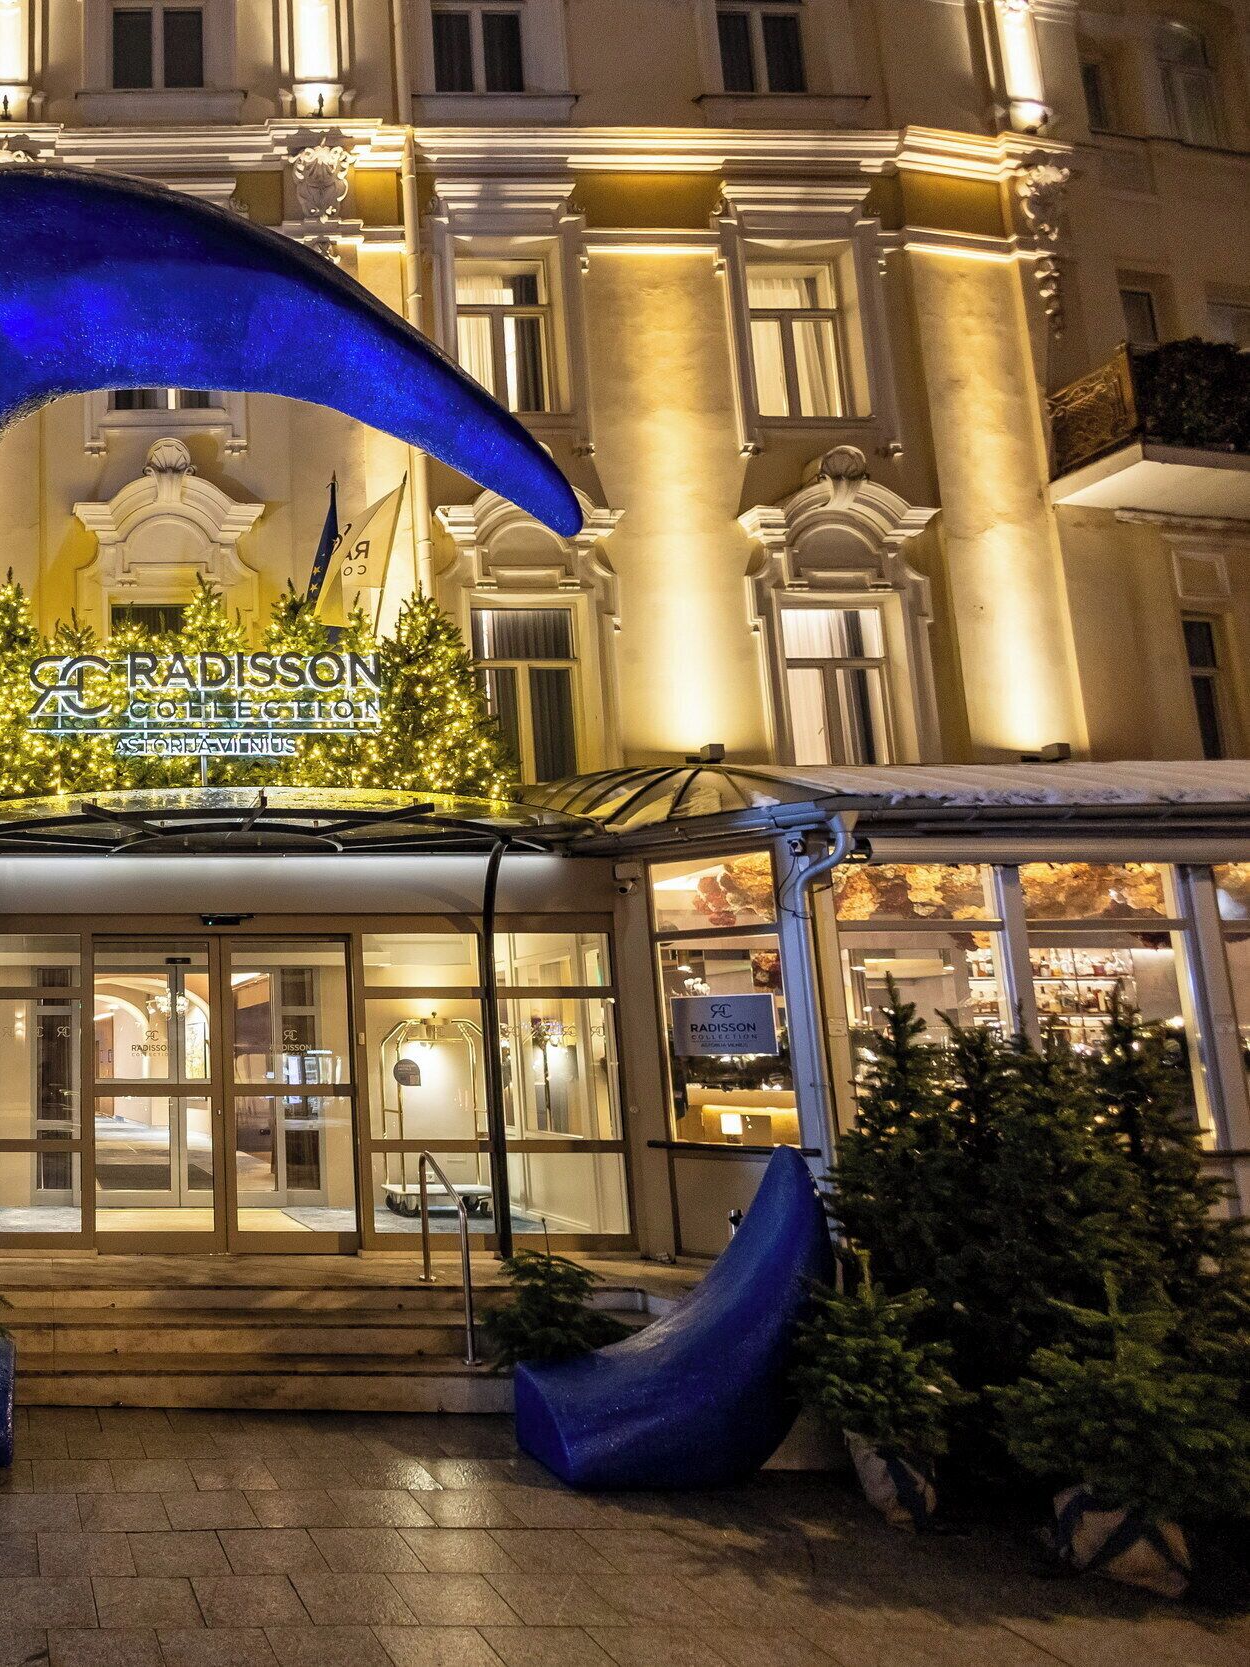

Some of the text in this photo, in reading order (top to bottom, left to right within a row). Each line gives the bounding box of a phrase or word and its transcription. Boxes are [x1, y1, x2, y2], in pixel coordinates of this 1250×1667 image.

[129, 652, 382, 688] RADISSON
[129, 700, 380, 720] COLLECTION
[115, 736, 296, 754] ASTORIJA VILNIUS
[690, 1022, 757, 1033] RADISSON
[131, 1044, 169, 1052] RADISSO
